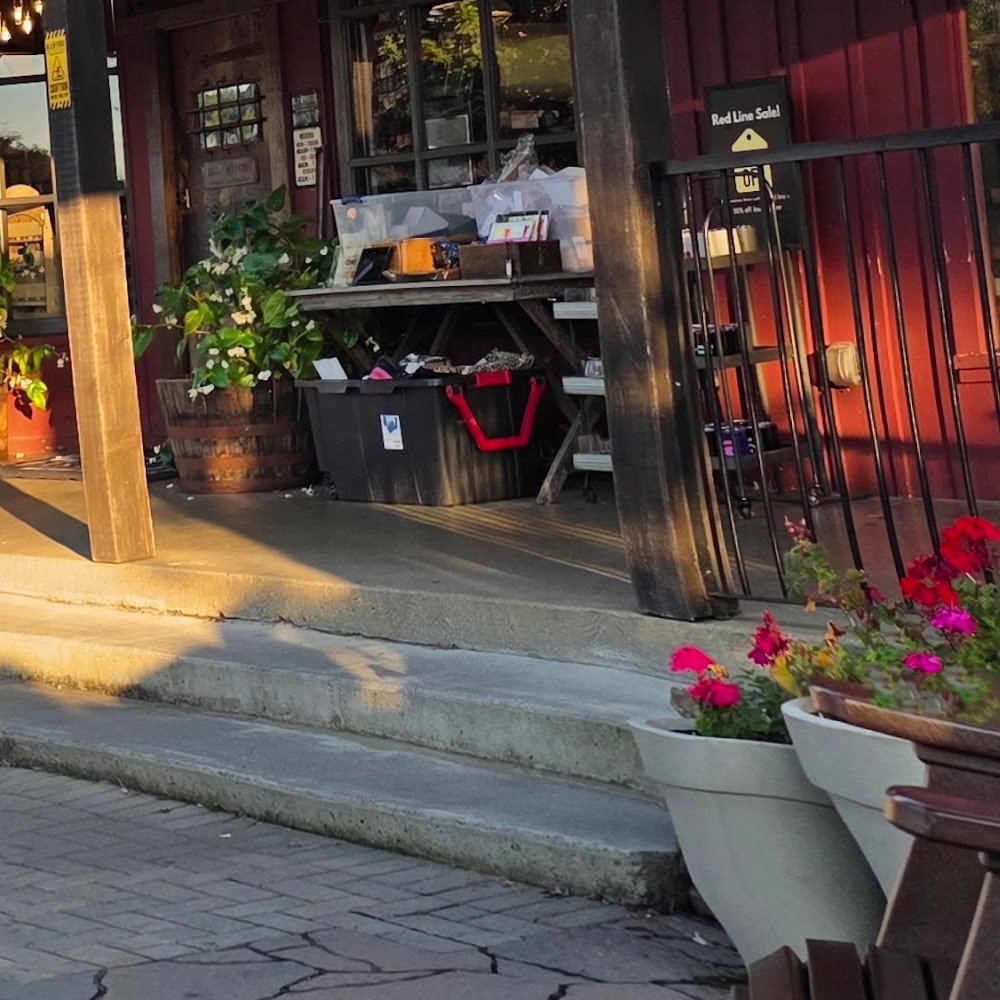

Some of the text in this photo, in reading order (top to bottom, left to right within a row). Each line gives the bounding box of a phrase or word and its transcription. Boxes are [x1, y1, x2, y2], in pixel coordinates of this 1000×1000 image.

[711, 104, 780, 126] Red Line Sale!
